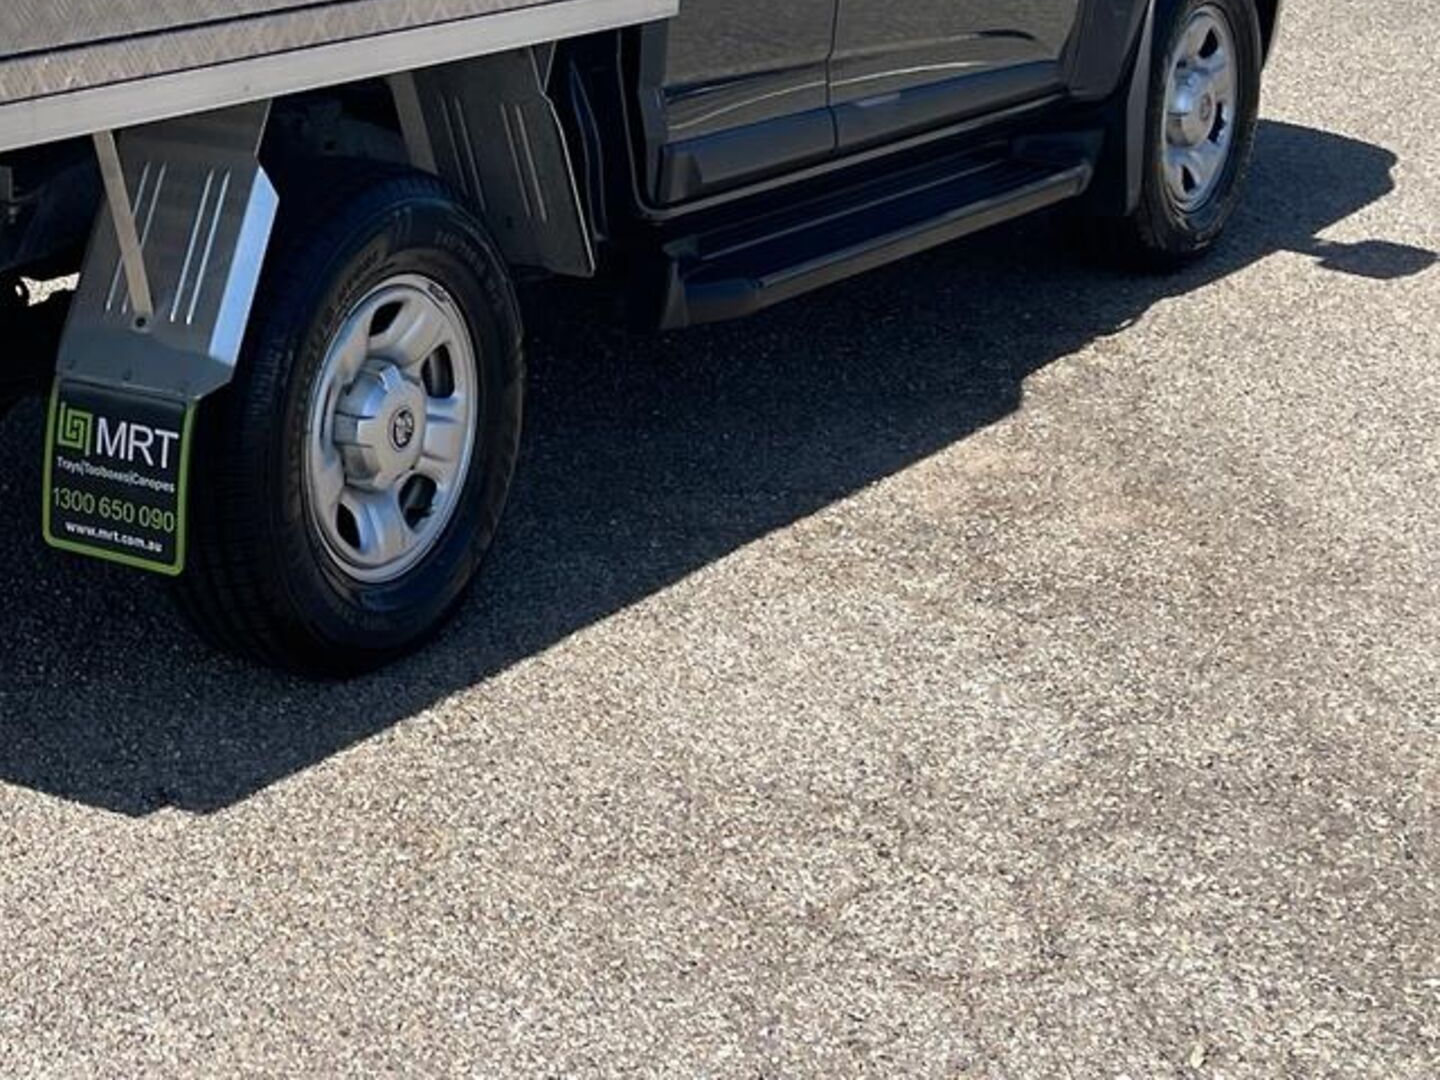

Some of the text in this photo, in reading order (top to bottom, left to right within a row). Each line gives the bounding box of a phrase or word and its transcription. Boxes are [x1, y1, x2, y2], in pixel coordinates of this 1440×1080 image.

[96, 416, 179, 469] MRT
[53, 486, 175, 534] 1300 650 090
[64, 520, 164, 553] www.mrt.com.au
